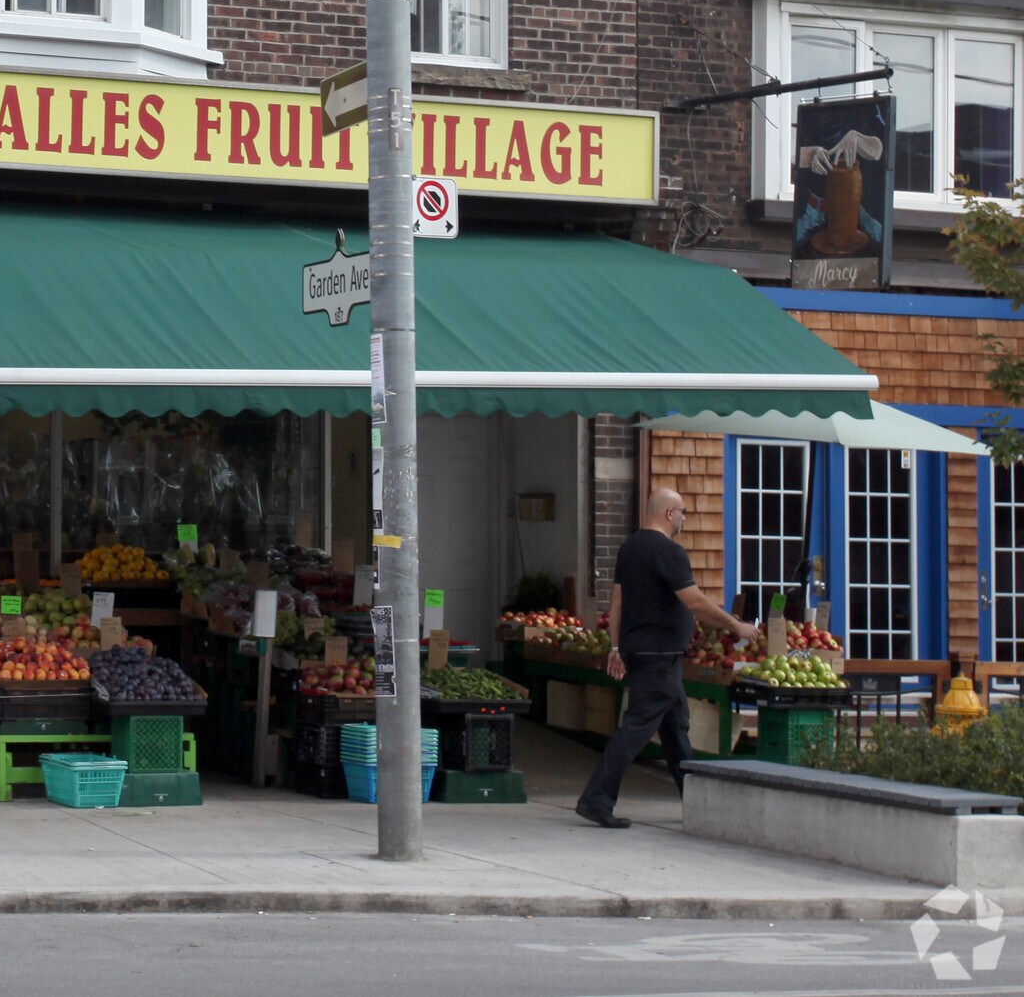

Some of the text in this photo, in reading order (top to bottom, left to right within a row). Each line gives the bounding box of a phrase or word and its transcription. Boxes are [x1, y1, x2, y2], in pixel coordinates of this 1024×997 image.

[412, 112, 604, 187] ILLAGE
[309, 265, 369, 299] Garden Ave
[808, 259, 858, 290] Marcy
